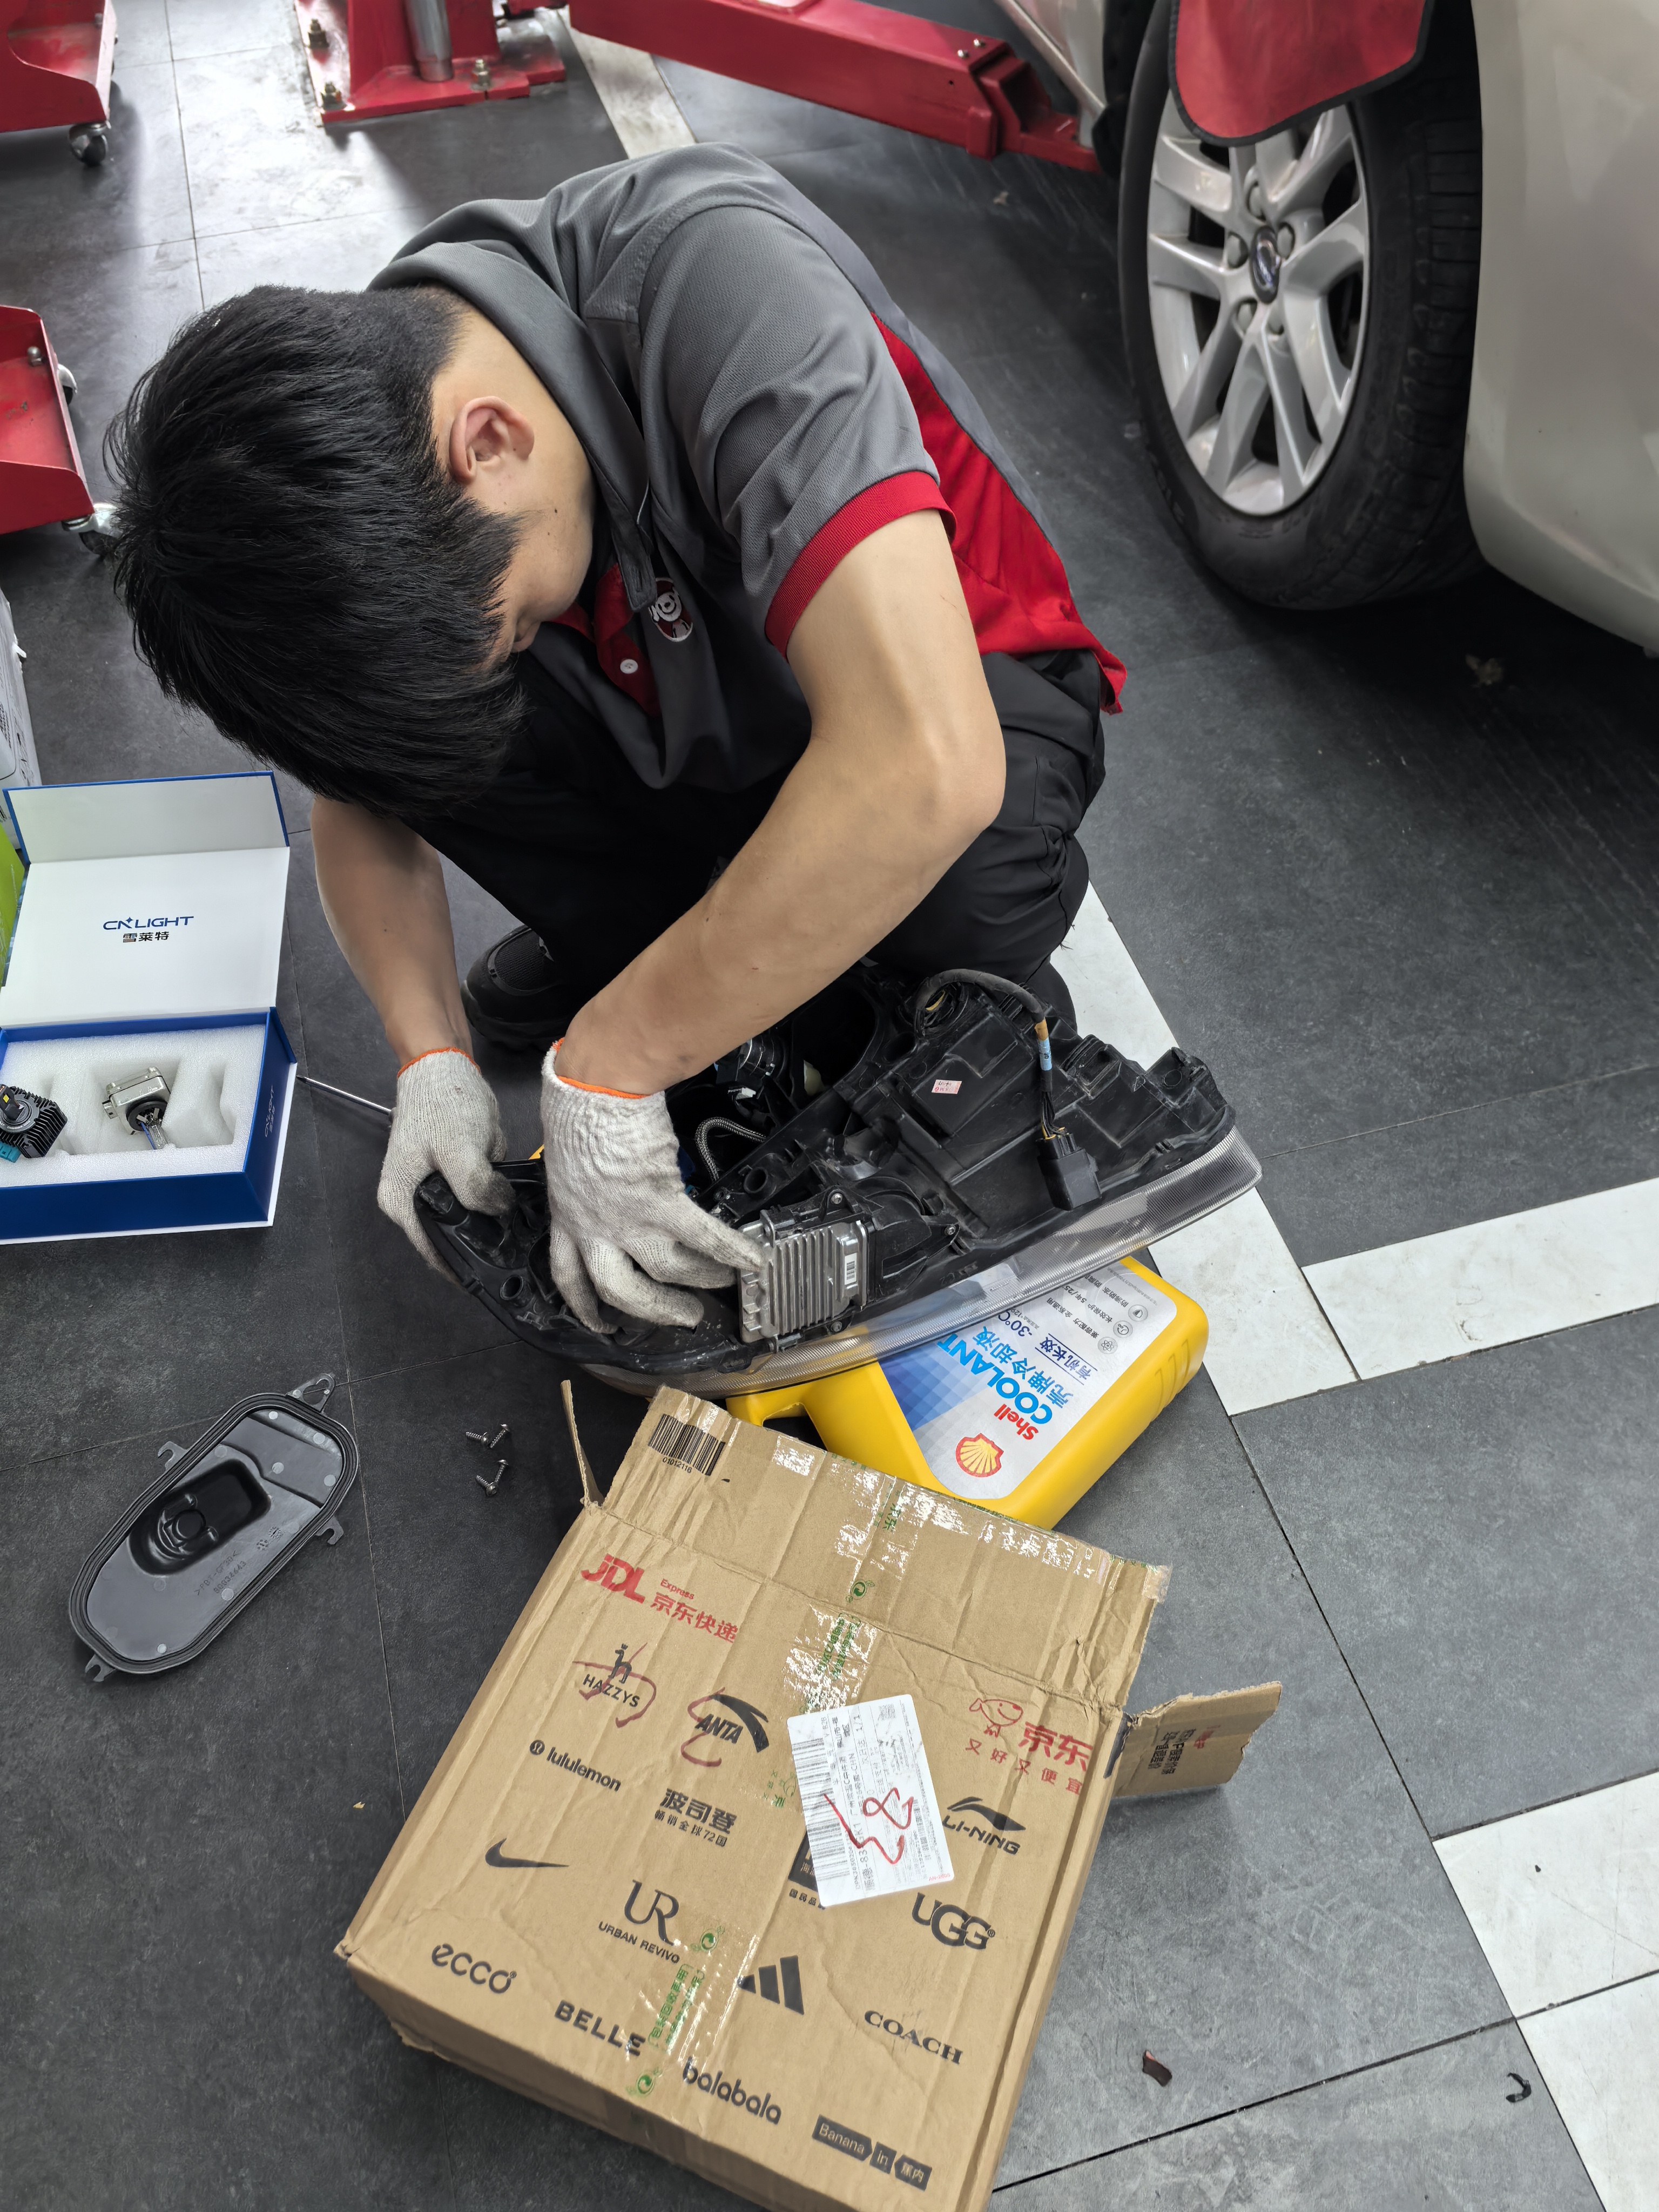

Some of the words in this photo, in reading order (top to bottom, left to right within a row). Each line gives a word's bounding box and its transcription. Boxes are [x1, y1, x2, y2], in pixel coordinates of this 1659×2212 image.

[123, 931, 170, 943] 雪莱特
[1046, 1297, 1073, 1318] 全系通用
[1087, 1301, 1113, 1323] 长效保护
[1102, 1286, 1128, 1307] 防沸防冻
[1072, 1317, 1099, 1338] 兼容配方
[936, 1333, 1053, 1424] COOLANT
[972, 1326, 1074, 1408] 壳牌冷却液
[1039, 1337, 1094, 1380] 有机长效
[994, 1404, 1038, 1440] Shell
[663, 1457, 692, 1473] 01012116
[581, 1553, 645, 1604] JDL
[660, 1578, 694, 1600] Express
[650, 1591, 739, 1644] 京东快递
[583, 1674, 640, 1708] HAZZYS
[695, 1714, 744, 1744] ANTA
[1018, 1722, 1093, 1772] 京东
[546, 1746, 622, 1792] lululemon
[965, 1738, 1082, 1795] 又好又便宜
[655, 1809, 727, 1847] 畅销全球72国
[659, 1788, 737, 1835] 波司登
[942, 1816, 1021, 1855] LI-NING
[624, 1879, 679, 1946] UR
[598, 1921, 637, 1945] URBAN
[640, 1940, 680, 1964] REVIVO
[555, 2000, 646, 2056] BELLE
[865, 2010, 963, 2065] COACH
[683, 2055, 781, 2125] balabala
[818, 2122, 865, 2154] Banana
[876, 2149, 889, 2167] in
